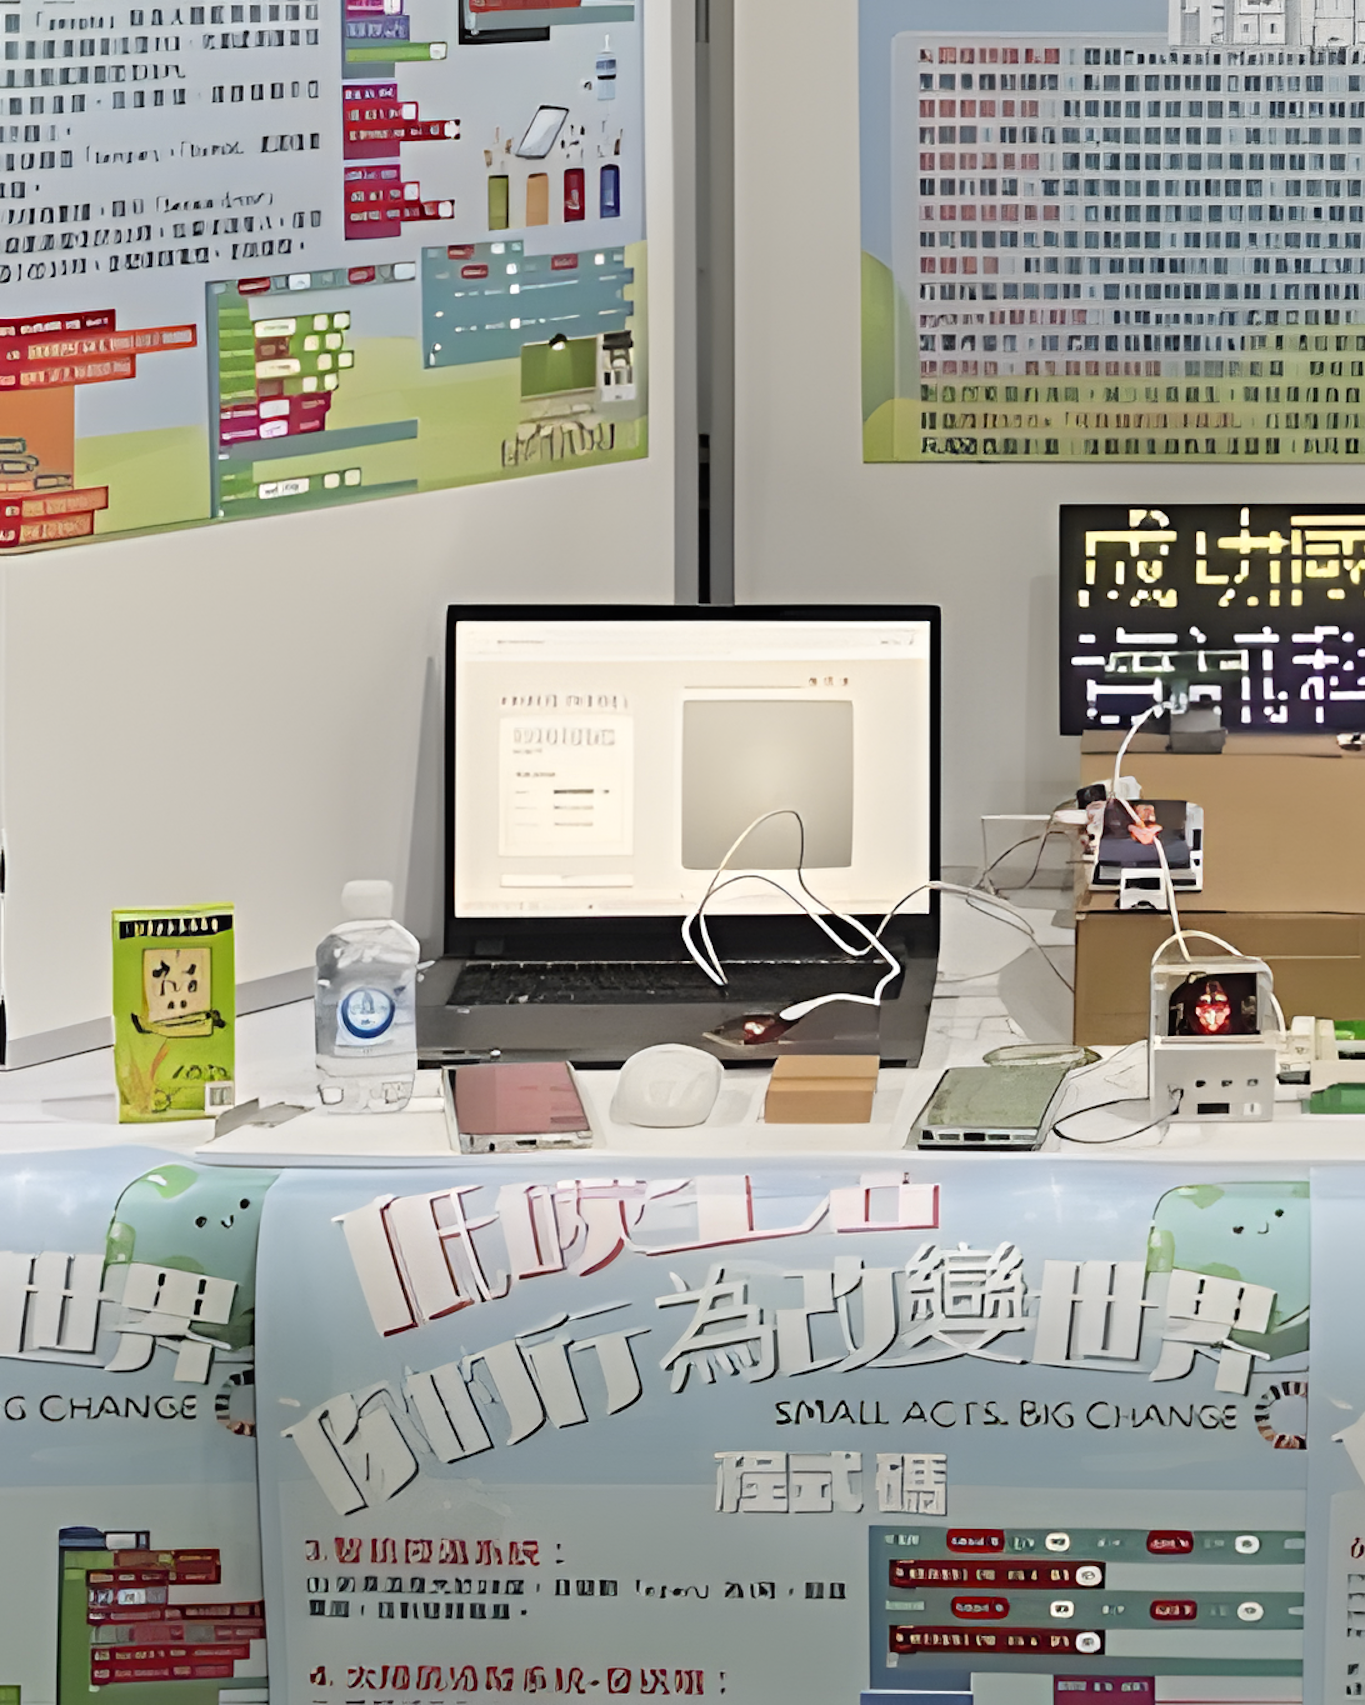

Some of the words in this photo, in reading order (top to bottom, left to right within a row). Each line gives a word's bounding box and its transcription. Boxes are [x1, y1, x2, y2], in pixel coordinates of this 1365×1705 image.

[40, 1394, 198, 1422] CHANGE
[774, 1400, 889, 1426] SMALL
[1020, 1400, 1075, 1429] BIG
[1086, 1401, 1238, 1430] CHANGE
[714, 1450, 948, 1517] 程式碼
